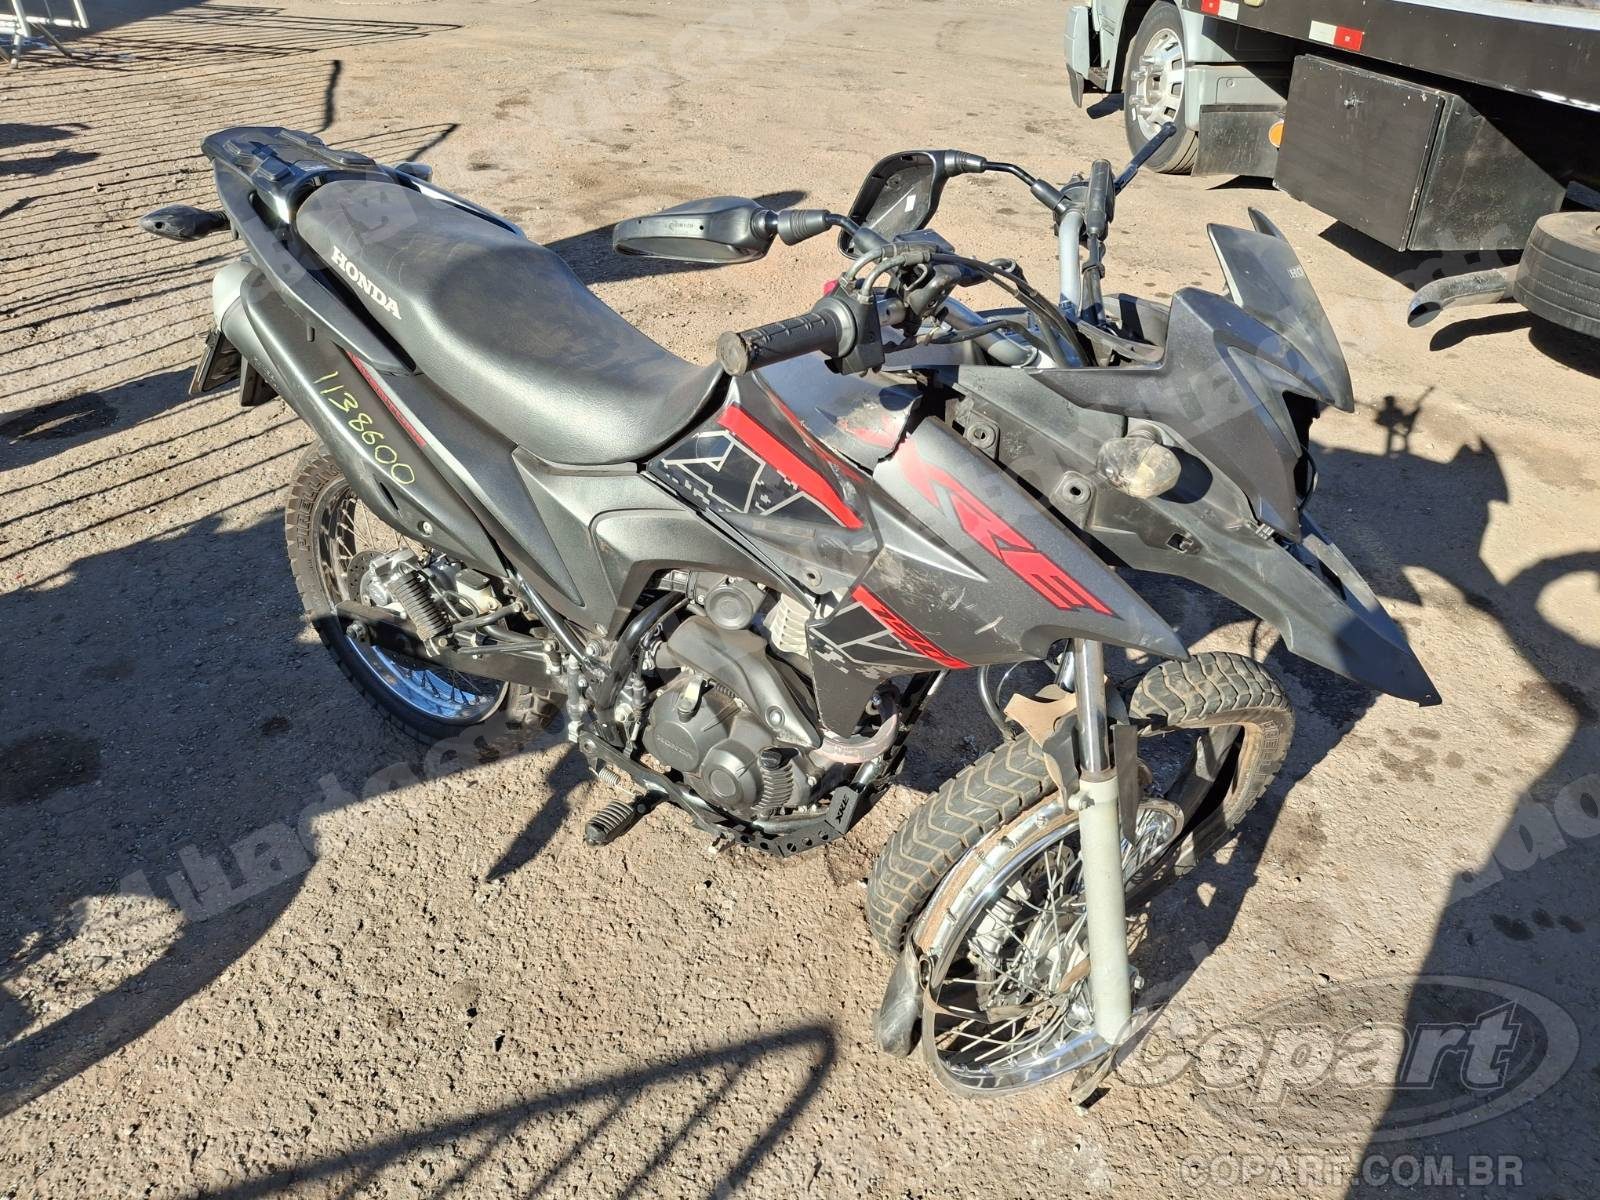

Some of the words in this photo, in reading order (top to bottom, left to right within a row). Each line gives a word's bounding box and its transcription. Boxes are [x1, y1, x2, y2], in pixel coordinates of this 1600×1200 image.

[332, 246, 402, 320] HONDA
[313, 371, 415, 485] 1138600
[835, 793, 850, 824] XRE
